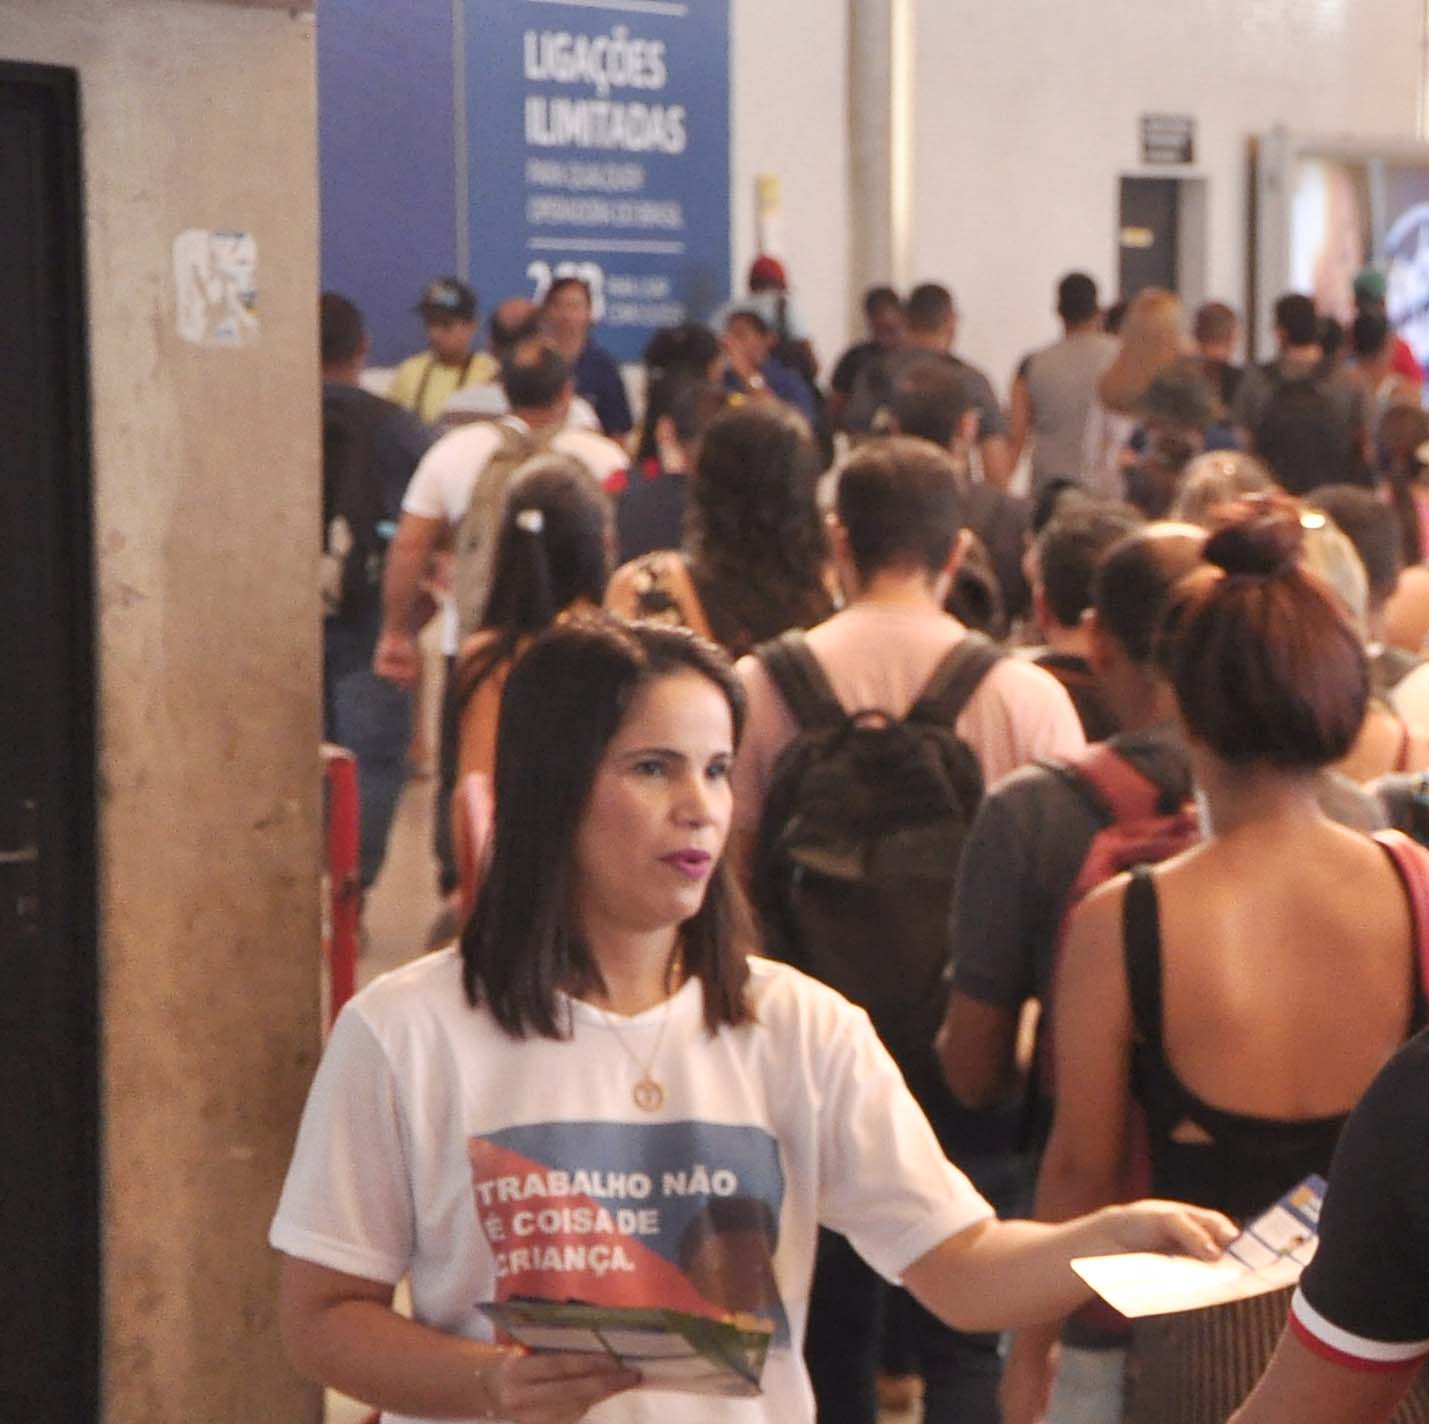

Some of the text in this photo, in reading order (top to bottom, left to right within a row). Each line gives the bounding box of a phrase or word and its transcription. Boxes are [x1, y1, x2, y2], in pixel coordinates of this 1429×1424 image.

[524, 24, 667, 96] LIGAÇÕES
[525, 96, 687, 154] ILIMITADAS
[475, 1163, 739, 1206] TRABALHO NÃO
[483, 1206, 662, 1242] É COISA DE
